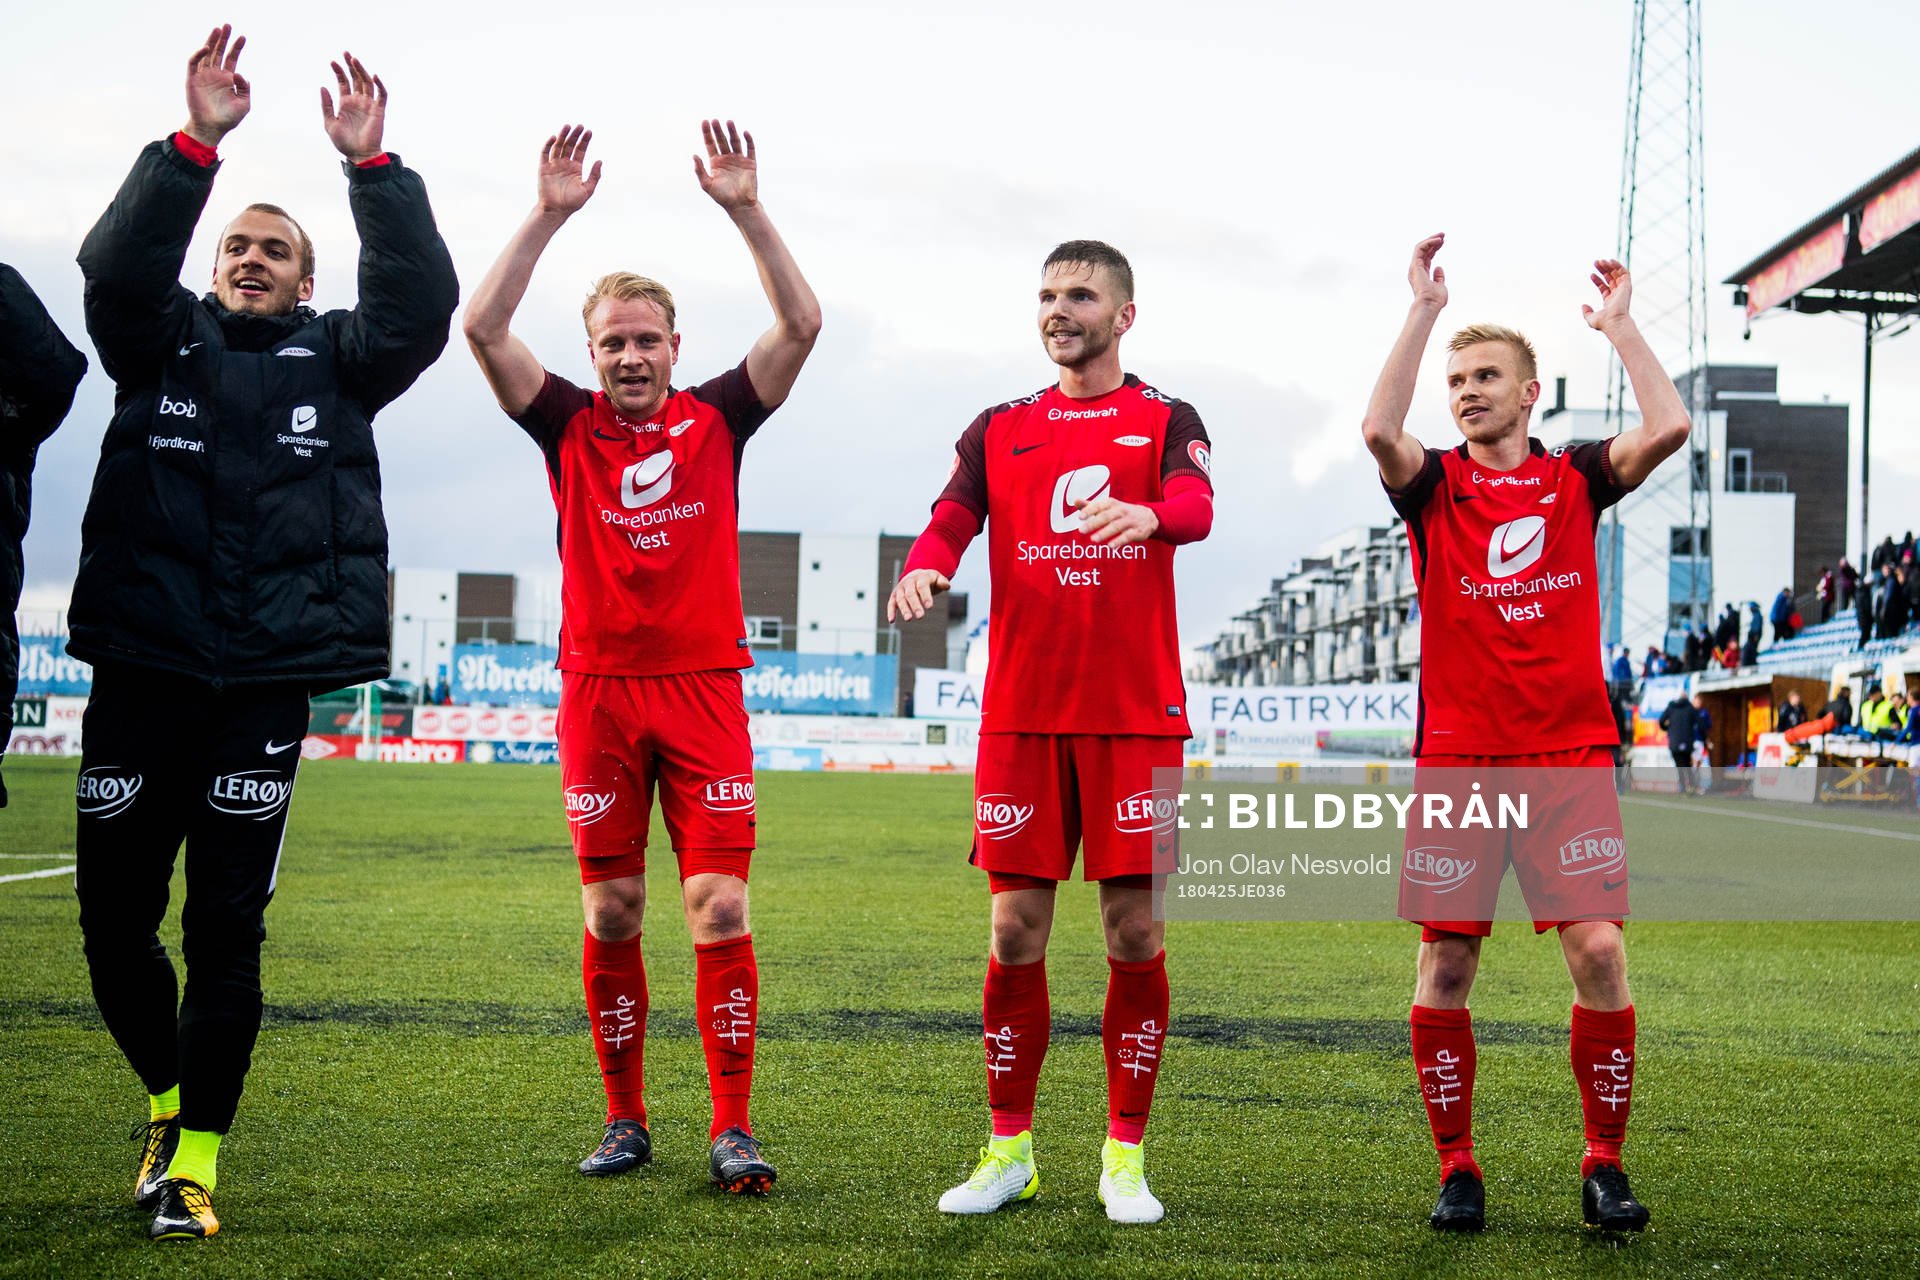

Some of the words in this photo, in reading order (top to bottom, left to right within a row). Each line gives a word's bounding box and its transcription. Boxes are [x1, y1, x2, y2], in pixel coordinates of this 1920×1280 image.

[159, 395, 197, 418] bob
[276, 433, 329, 448] Sparebanken
[293, 446, 313, 457] Vest
[598, 501, 705, 528] parebanken
[628, 530, 670, 549] Vest
[1017, 540, 1147, 566] Sparebanken
[1055, 567, 1101, 586] Vest
[1460, 571, 1582, 600] Sparebanken
[1498, 601, 1545, 623] Vest
[1210, 694, 1412, 723] FAGTRYKK
[213, 776, 289, 803] LERØY
[706, 782, 756, 801] LERØ
[1405, 850, 1472, 878] LERØY
[1559, 837, 1624, 867] LERØY
[600, 995, 637, 1049] tide
[712, 988, 752, 1045] tide
[986, 1026, 1021, 1080] tide
[1117, 1019, 1162, 1079] tide
[1422, 1049, 1461, 1112] tide
[1593, 1048, 1632, 1112] tide
